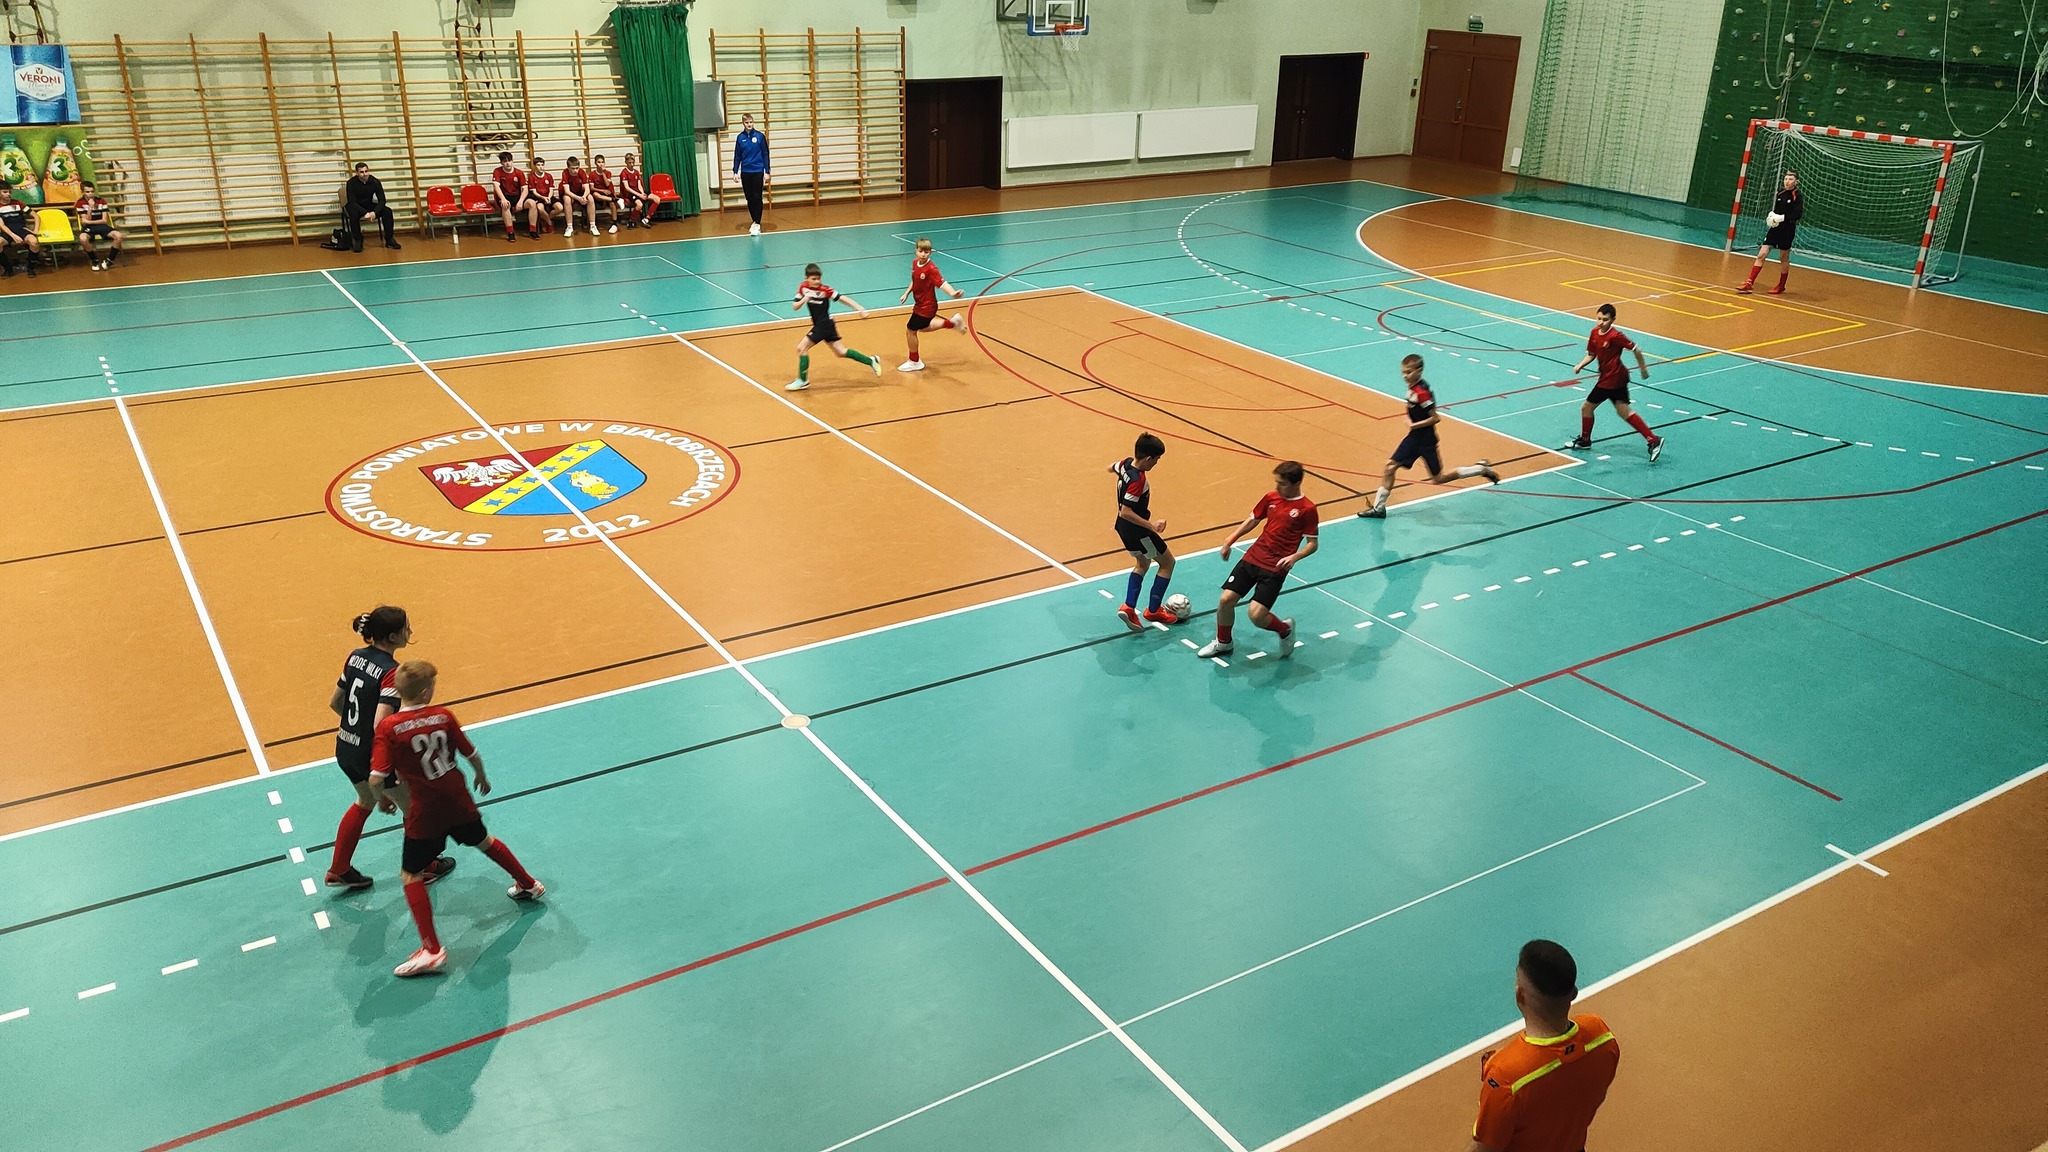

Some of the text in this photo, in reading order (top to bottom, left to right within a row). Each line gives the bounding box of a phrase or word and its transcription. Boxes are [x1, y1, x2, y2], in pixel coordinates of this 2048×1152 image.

[19, 72, 61, 84] VERONI
[339, 422, 725, 546] STAROSTWO POWIATOWE W BIAŁOBRZEGACH
[542, 514, 650, 543] 2012
[347, 677, 365, 727] 5
